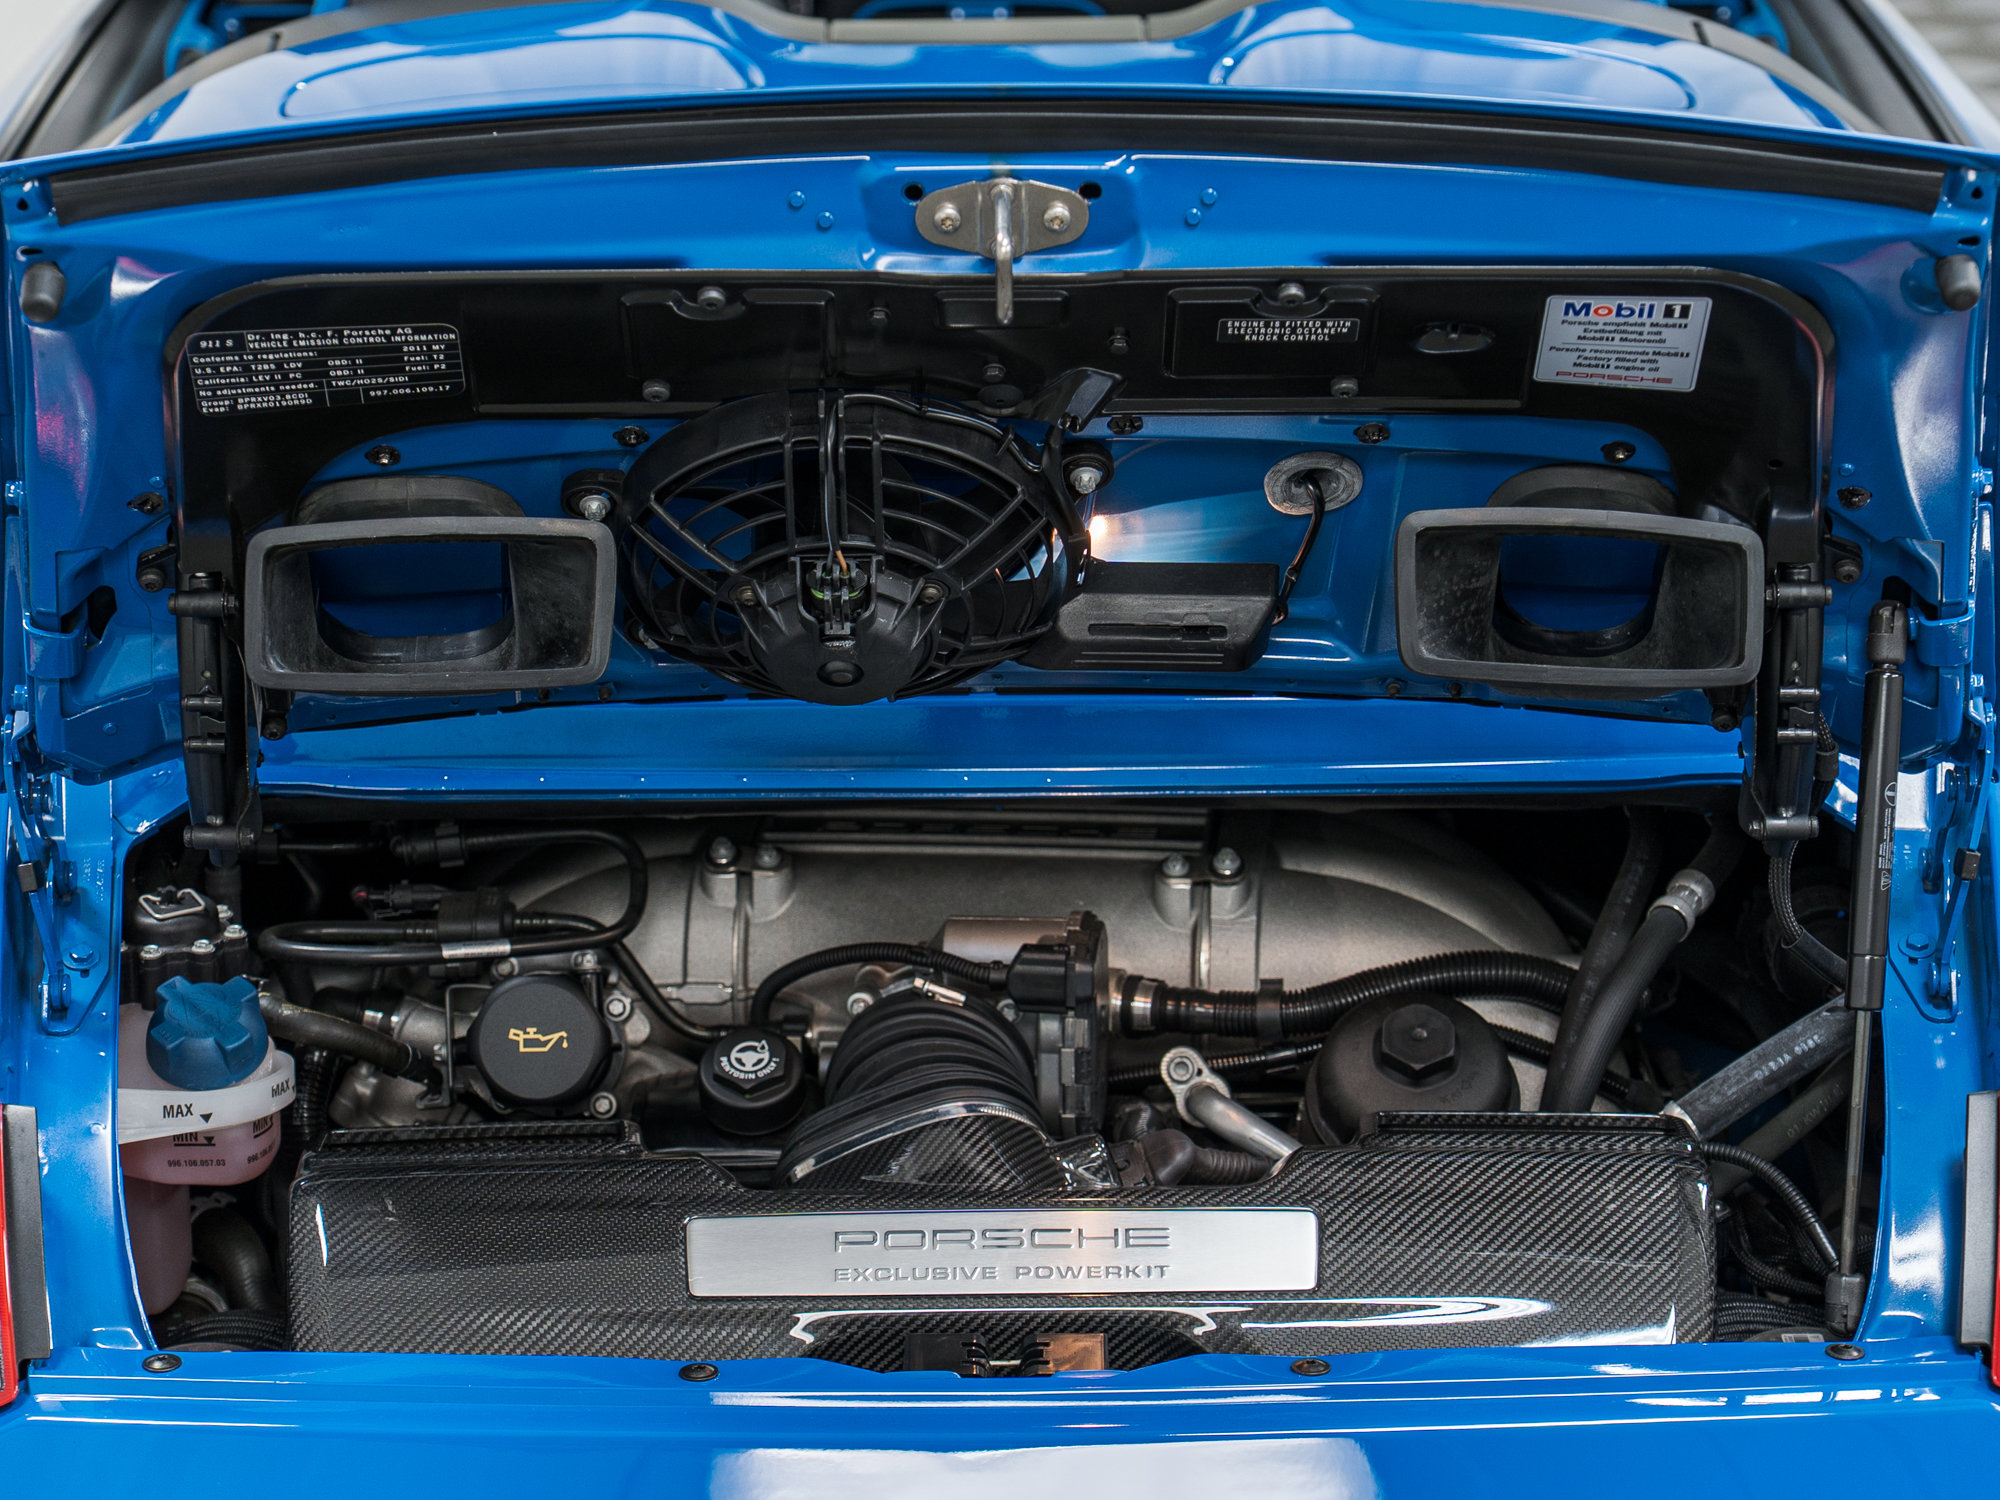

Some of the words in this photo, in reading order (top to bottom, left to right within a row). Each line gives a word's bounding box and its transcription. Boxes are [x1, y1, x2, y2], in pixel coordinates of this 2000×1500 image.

[1563, 302, 1656, 318] Mobil
[1227, 320, 1265, 328] ENGINE
[1270, 320, 1280, 328] IS
[1285, 320, 1321, 328] FITTED
[1327, 320, 1351, 328] WITH
[247, 333, 265, 341] Dr.
[270, 332, 293, 340] Ing.
[299, 331, 321, 339] h.c.
[327, 329, 338, 337] F.
[344, 328, 392, 337] Porsche
[396, 327, 412, 335] AG
[1228, 327, 1291, 335] ELECTRONIC
[200, 340, 220, 349] 911
[225, 339, 234, 347] S
[248, 340, 289, 349] VEHICLE
[292, 338, 339, 347] EMISSION
[343, 336, 387, 345] CONTROL
[391, 333, 456, 342] INFORMATION
[1245, 334, 1279, 342] KNOCK
[1284, 334, 1330, 342] CONTROL
[192, 354, 240, 363] Conforms
[258, 351, 318, 360] regulations:
[1577, 354, 1613, 363] Factory
[1589, 348, 1650, 356] recommends
[194, 367, 216, 375] U.S.
[219, 365, 243, 373] EPA:
[283, 361, 303, 369] LDV
[197, 376, 249, 386] California:
[252, 374, 271, 382] LEV
[1556, 371, 1673, 384] PORSCHE
[216, 386, 276, 396] adjustments
[279, 382, 318, 391] needed.
[201, 399, 234, 407] Group:
[202, 405, 229, 413] Evap:
[720, 1056, 756, 1080] PENTOSIN
[271, 1078, 290, 1099] MAX
[162, 1103, 194, 1119] MAX
[252, 1118, 269, 1134] MIN
[172, 1132, 199, 1142] MIN
[834, 1226, 1172, 1253] PORSCHE
[834, 1265, 999, 1283] EXCLUSIVE
[1015, 1264, 1172, 1282] POWERKIT
